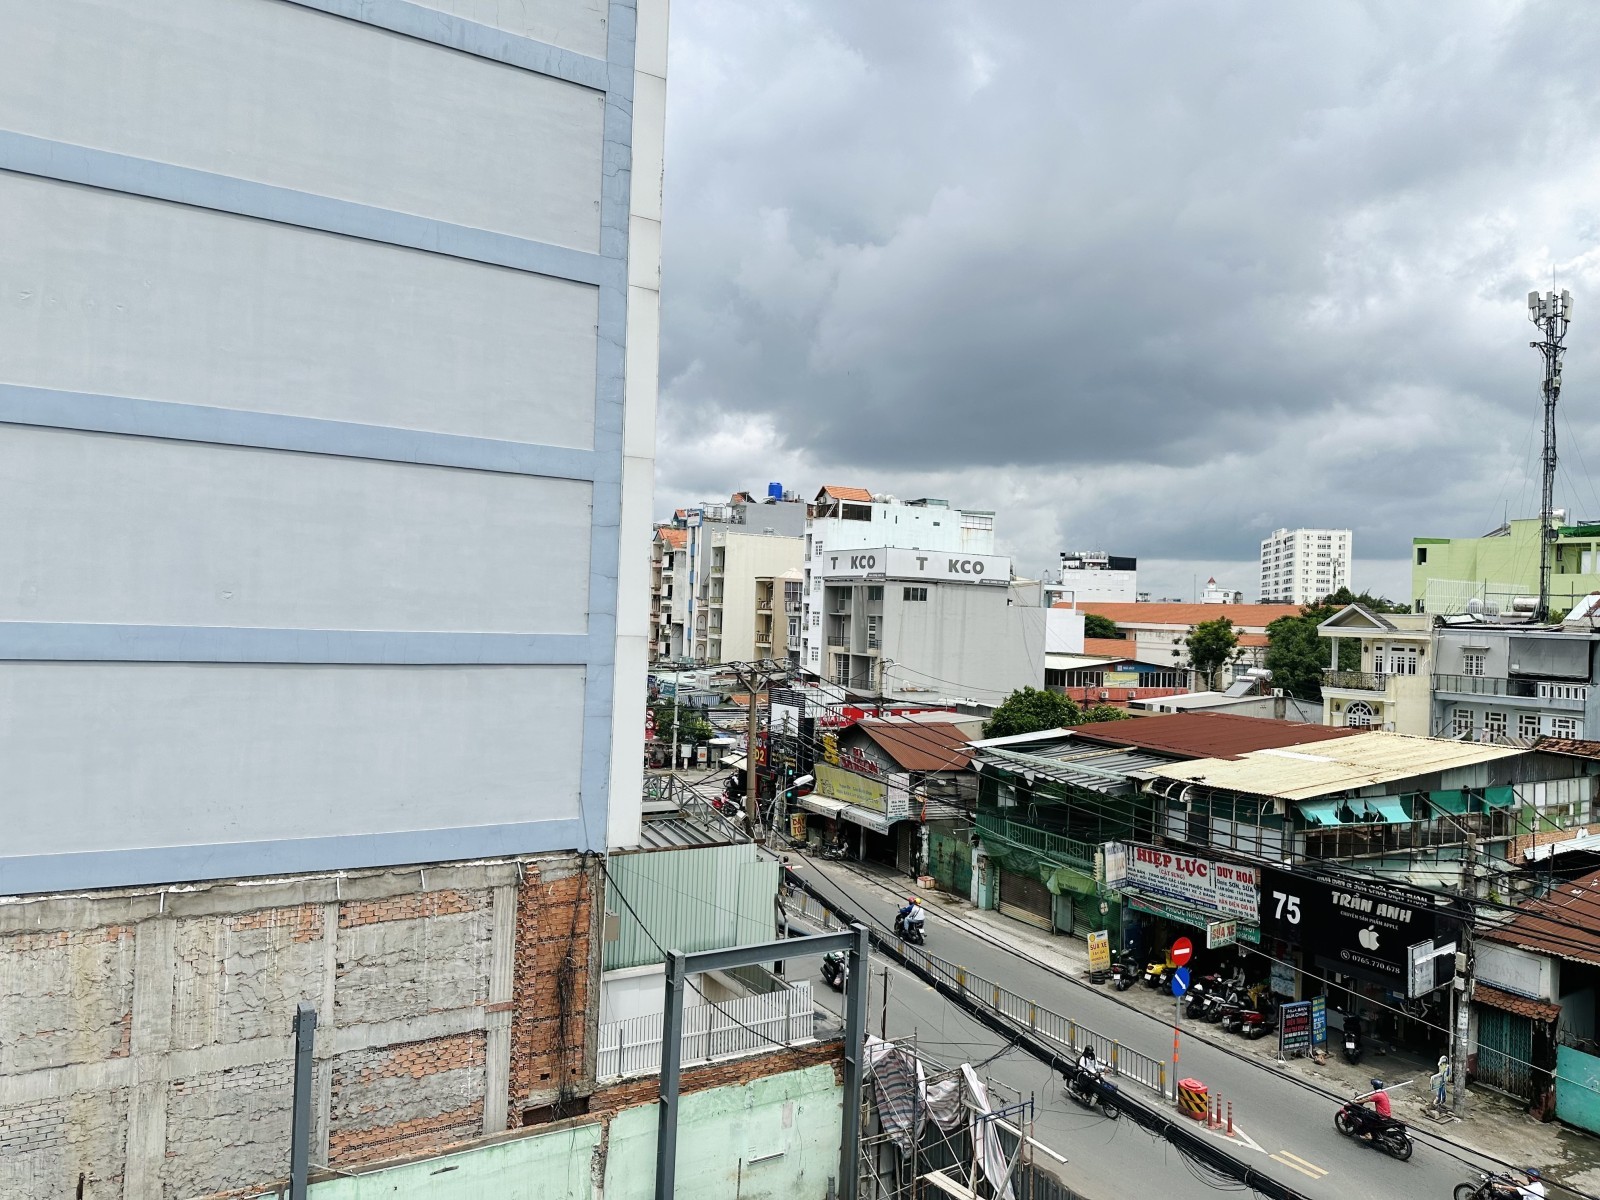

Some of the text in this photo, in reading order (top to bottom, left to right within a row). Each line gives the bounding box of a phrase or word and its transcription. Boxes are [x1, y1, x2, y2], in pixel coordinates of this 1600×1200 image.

[948, 558, 985, 575] KCO
[1216, 865, 1234, 880] DUY
[1272, 890, 1301, 925] 75
[1376, 903, 1412, 923] ANH
